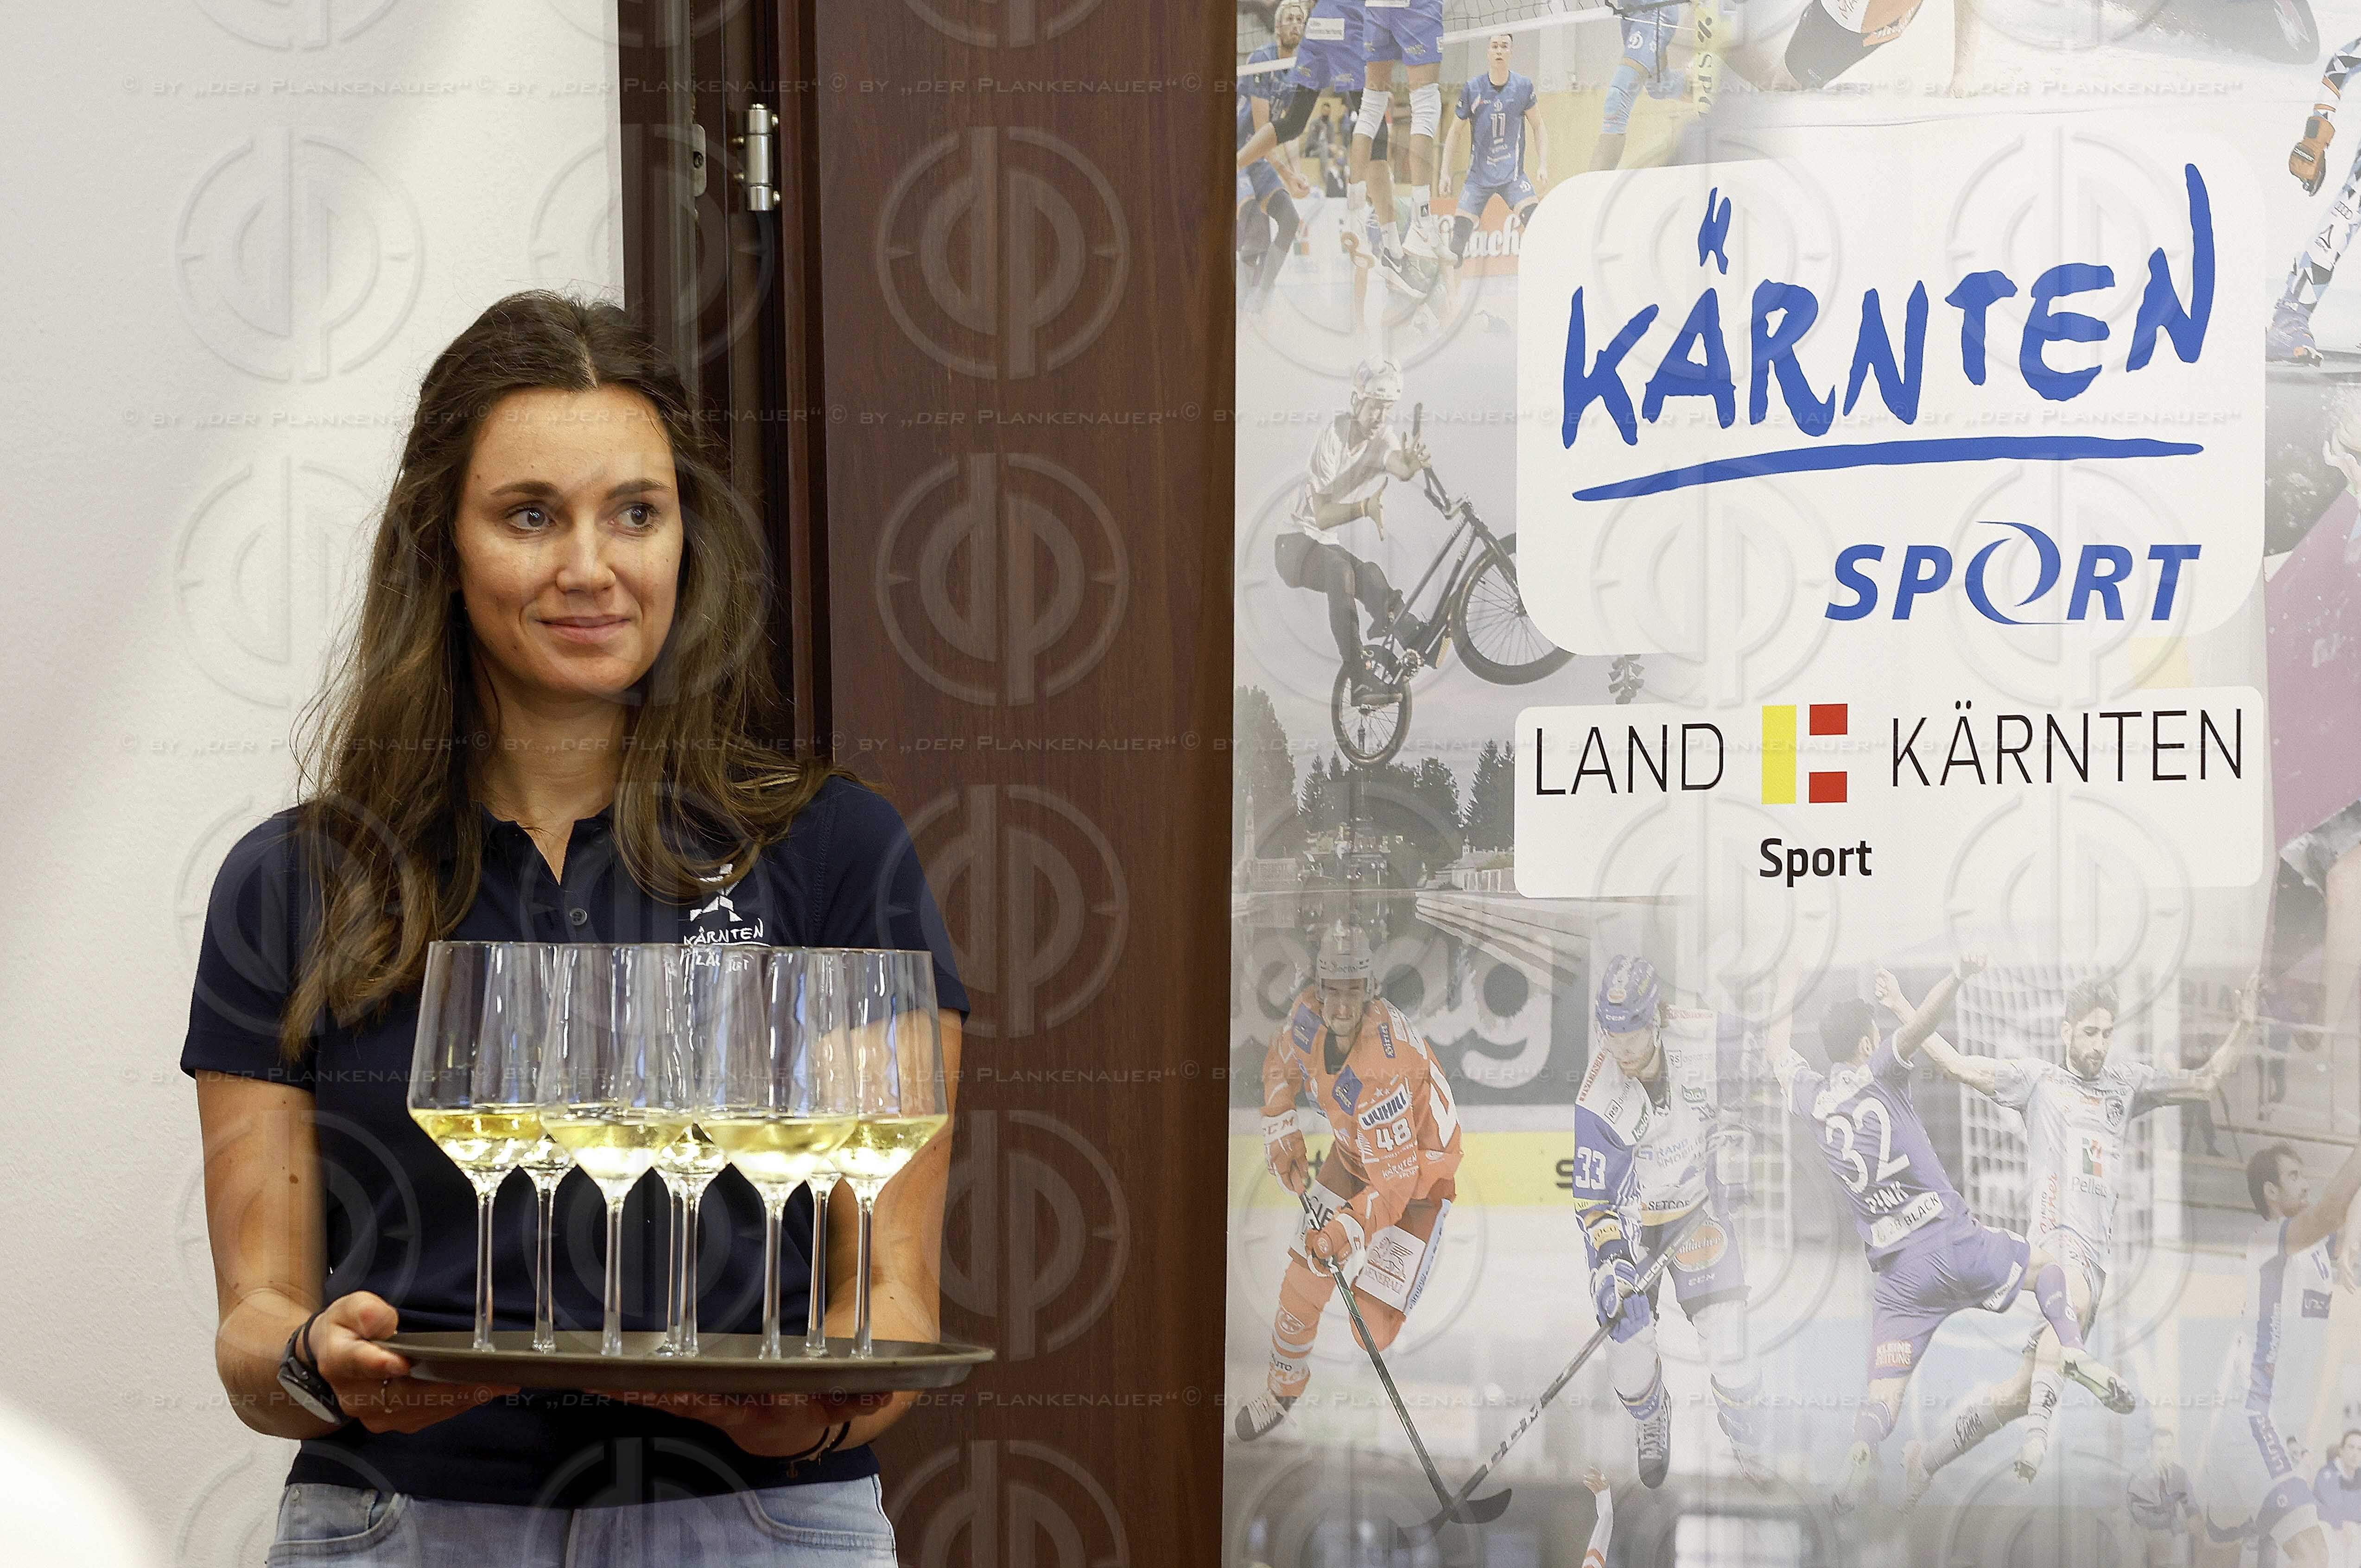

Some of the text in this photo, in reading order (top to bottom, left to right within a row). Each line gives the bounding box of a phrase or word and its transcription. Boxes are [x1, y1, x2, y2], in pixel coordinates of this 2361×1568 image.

[1562, 164, 2215, 449] KÄRNTEN
[1825, 522, 2202, 625] SPORT
[1536, 699, 2242, 796] LAND KÄRNTEN
[1759, 837, 1872, 888] Sport
[1375, 1117, 1412, 1152] 48
[1574, 1146, 1607, 1190] 33
[1824, 1095, 1910, 1195] 32
[1864, 1181, 1909, 1214] PINK
